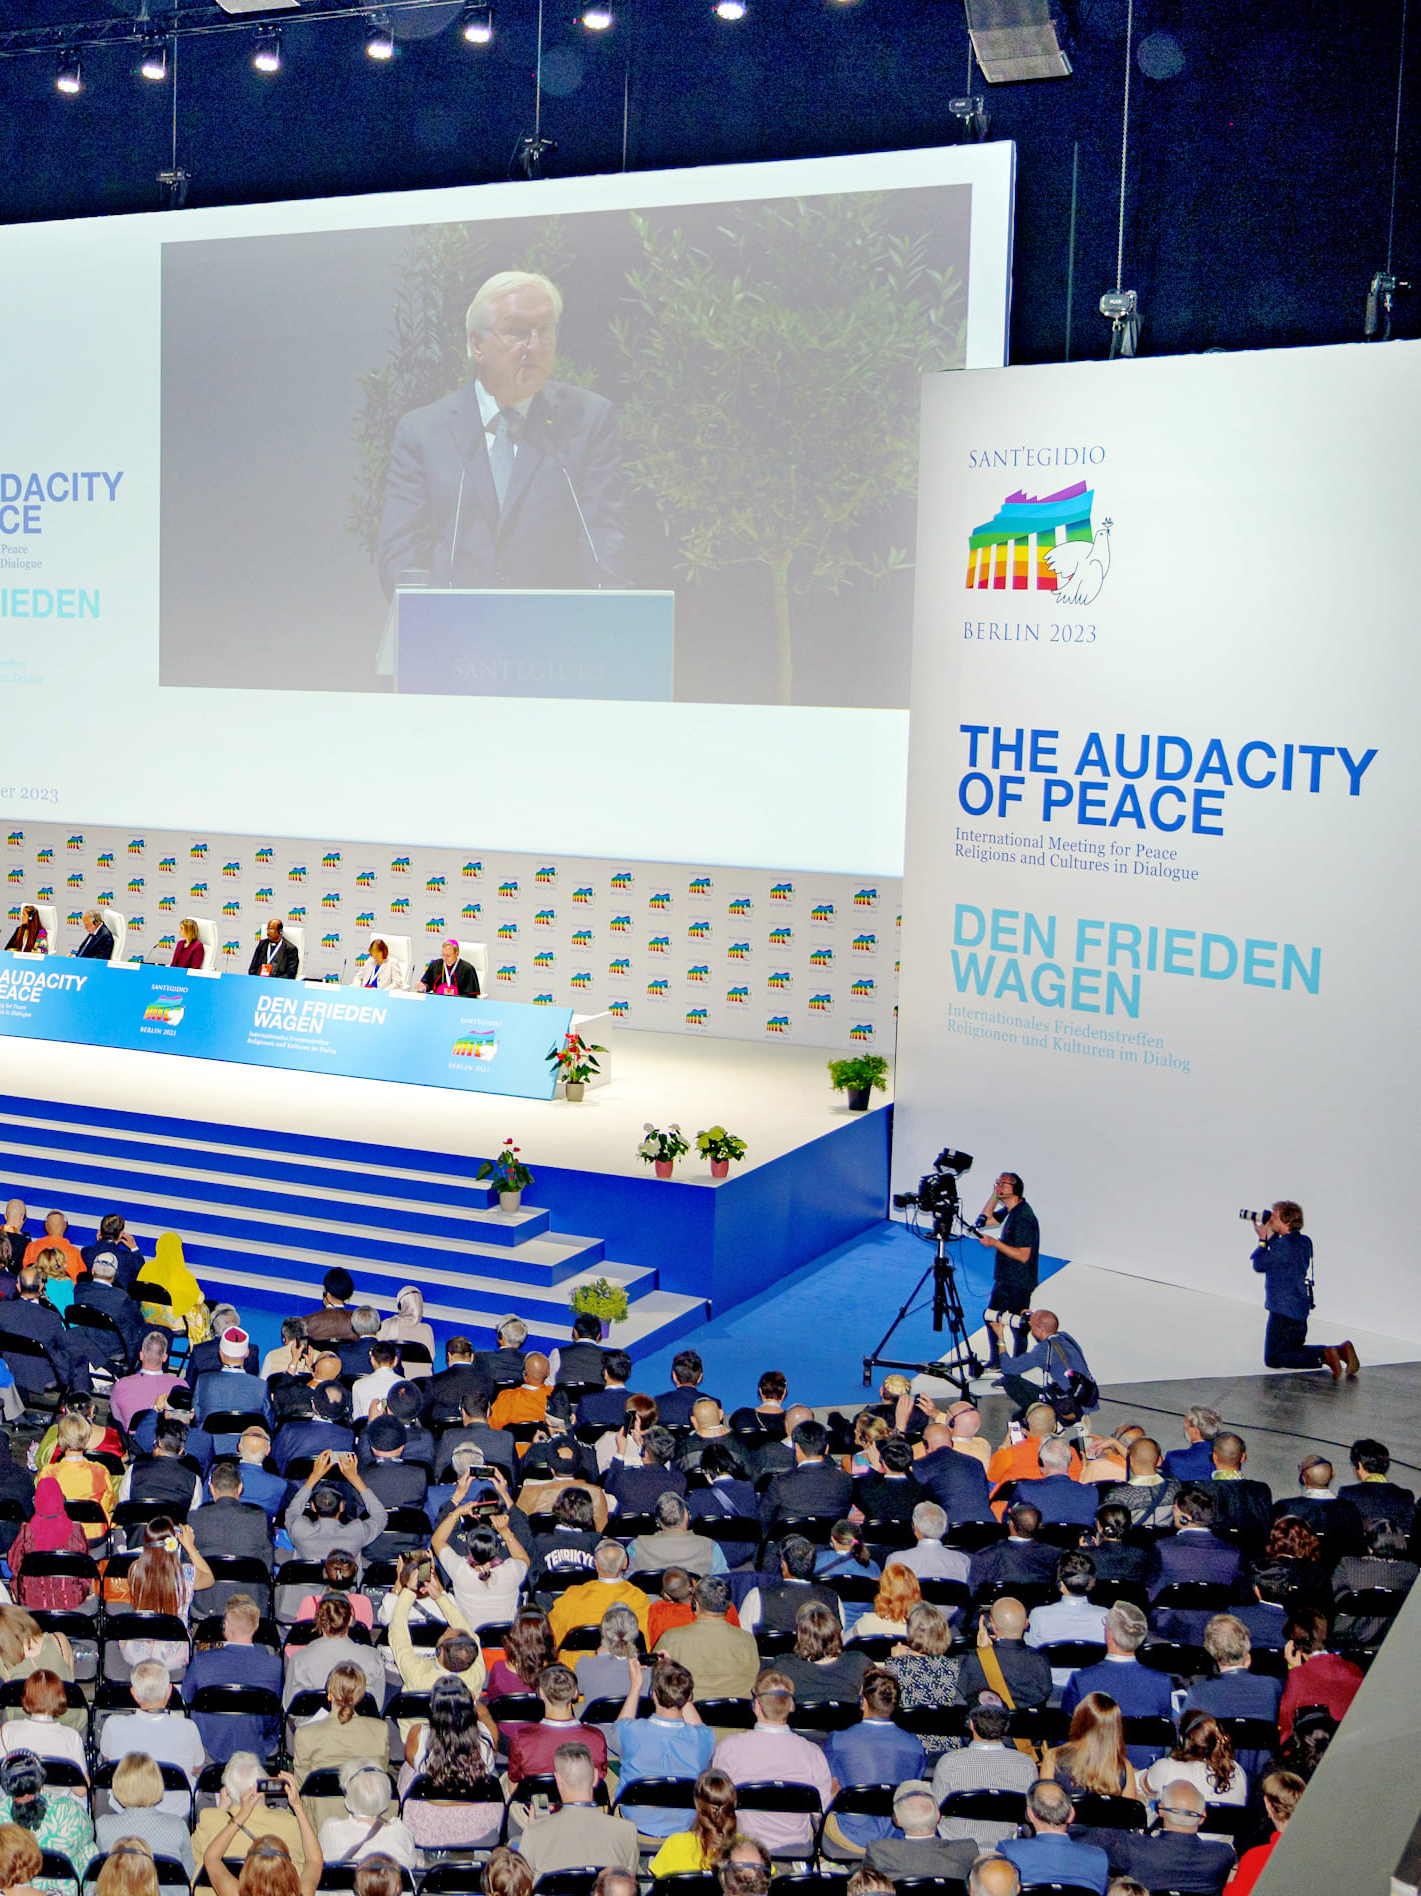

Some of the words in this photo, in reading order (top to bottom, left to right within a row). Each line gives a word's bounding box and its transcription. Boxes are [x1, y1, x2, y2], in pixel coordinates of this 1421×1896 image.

[967, 445, 1106, 470] SANT'EGIDIO
[0, 558, 42, 570] Dialogue
[1, 544, 28, 554] Peace
[962, 622, 1040, 642] BERLIN
[1050, 624, 1097, 644] 2023
[959, 724, 1059, 774] THE
[1074, 732, 1379, 798] AUDACITY
[20, 787, 59, 804] 2023
[958, 772, 1025, 818] OF
[1042, 778, 1225, 837] PEACE
[955, 827, 1044, 849] International
[1048, 836, 1106, 857] Meeting
[1110, 840, 1131, 856] for
[1136, 843, 1178, 860] Peace
[955, 843, 1016, 863] Religions
[1020, 850, 1046, 866] and
[1050, 853, 1110, 872] Cultures
[1114, 859, 1128, 874] in
[1133, 861, 1199, 882] Dialogue
[953, 903, 1056, 959] DEN
[1075, 918, 1321, 995] FRIEDEN
[950, 948, 1141, 1019] WAGEN
[254, 1010, 325, 1034] WAGEN
[257, 995, 298, 1015] DEN
[301, 1000, 387, 1025] FRIEDEN
[947, 1003, 1050, 1033] Internationales
[1054, 1020, 1164, 1049] Friedenstreffen
[947, 1019, 1017, 1043] Religionen
[1022, 1034, 1048, 1049] und
[1053, 1037, 1115, 1059] Kulturen
[1119, 1045, 1138, 1063] im
[1143, 1050, 1191, 1073] Dialog
